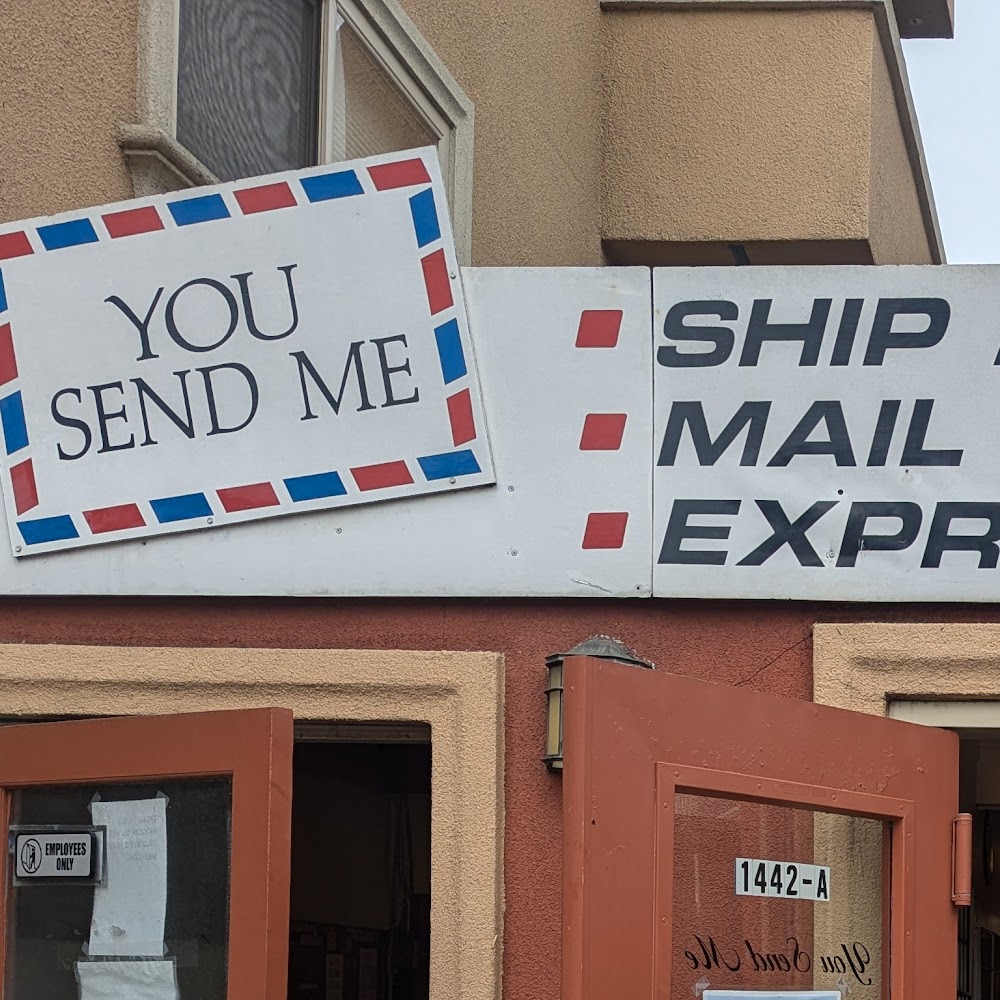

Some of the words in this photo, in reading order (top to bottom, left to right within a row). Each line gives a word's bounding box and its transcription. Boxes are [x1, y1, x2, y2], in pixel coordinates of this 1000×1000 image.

[105, 264, 300, 361] YOU
[656, 297, 951, 368] SHIP
[50, 361, 259, 461] SEND
[289, 333, 420, 421] ME
[656, 399, 964, 467] MAIL
[45, 842, 87, 856] EMPLOYEES
[56, 858, 74, 871] ONLY
[741, 861, 828, 899] 1442-A
